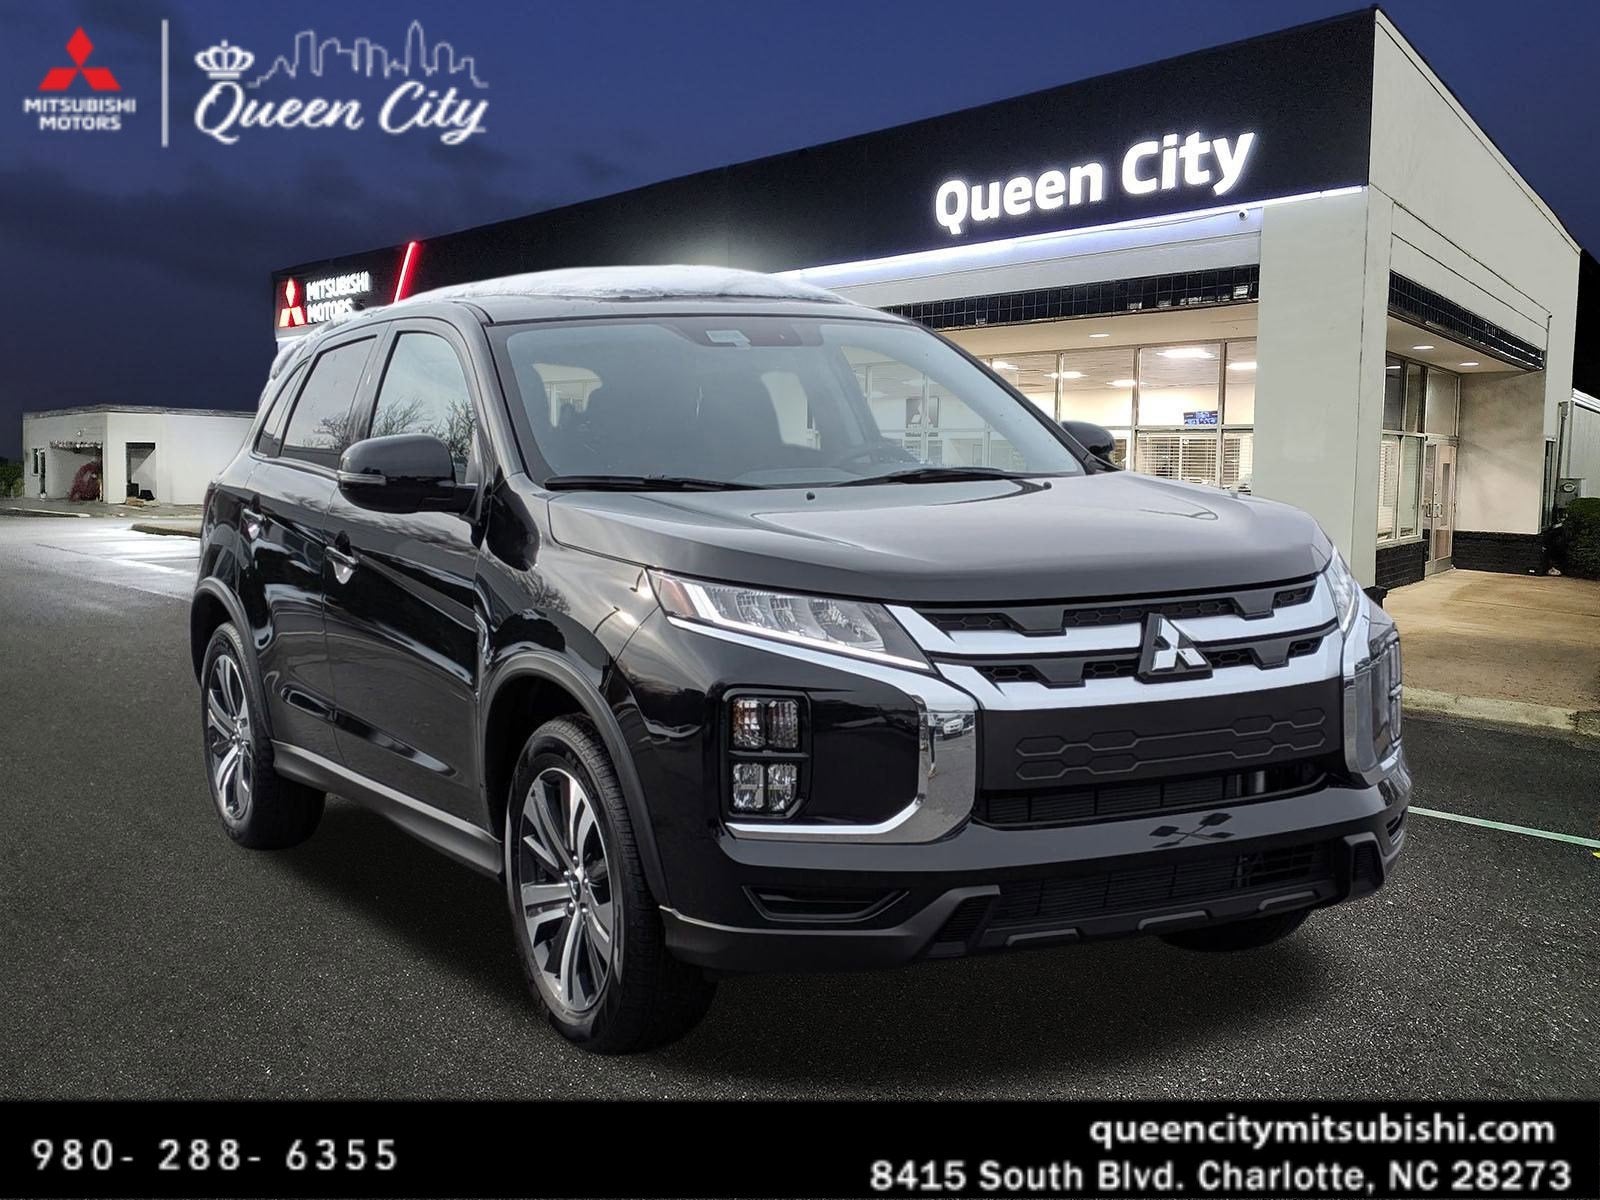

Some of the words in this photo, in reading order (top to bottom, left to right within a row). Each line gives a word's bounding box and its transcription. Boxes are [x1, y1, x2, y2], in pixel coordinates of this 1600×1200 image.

[936, 162, 1103, 234] Queen
[1122, 132, 1255, 195] City
[306, 270, 370, 301] MITSUBISHI
